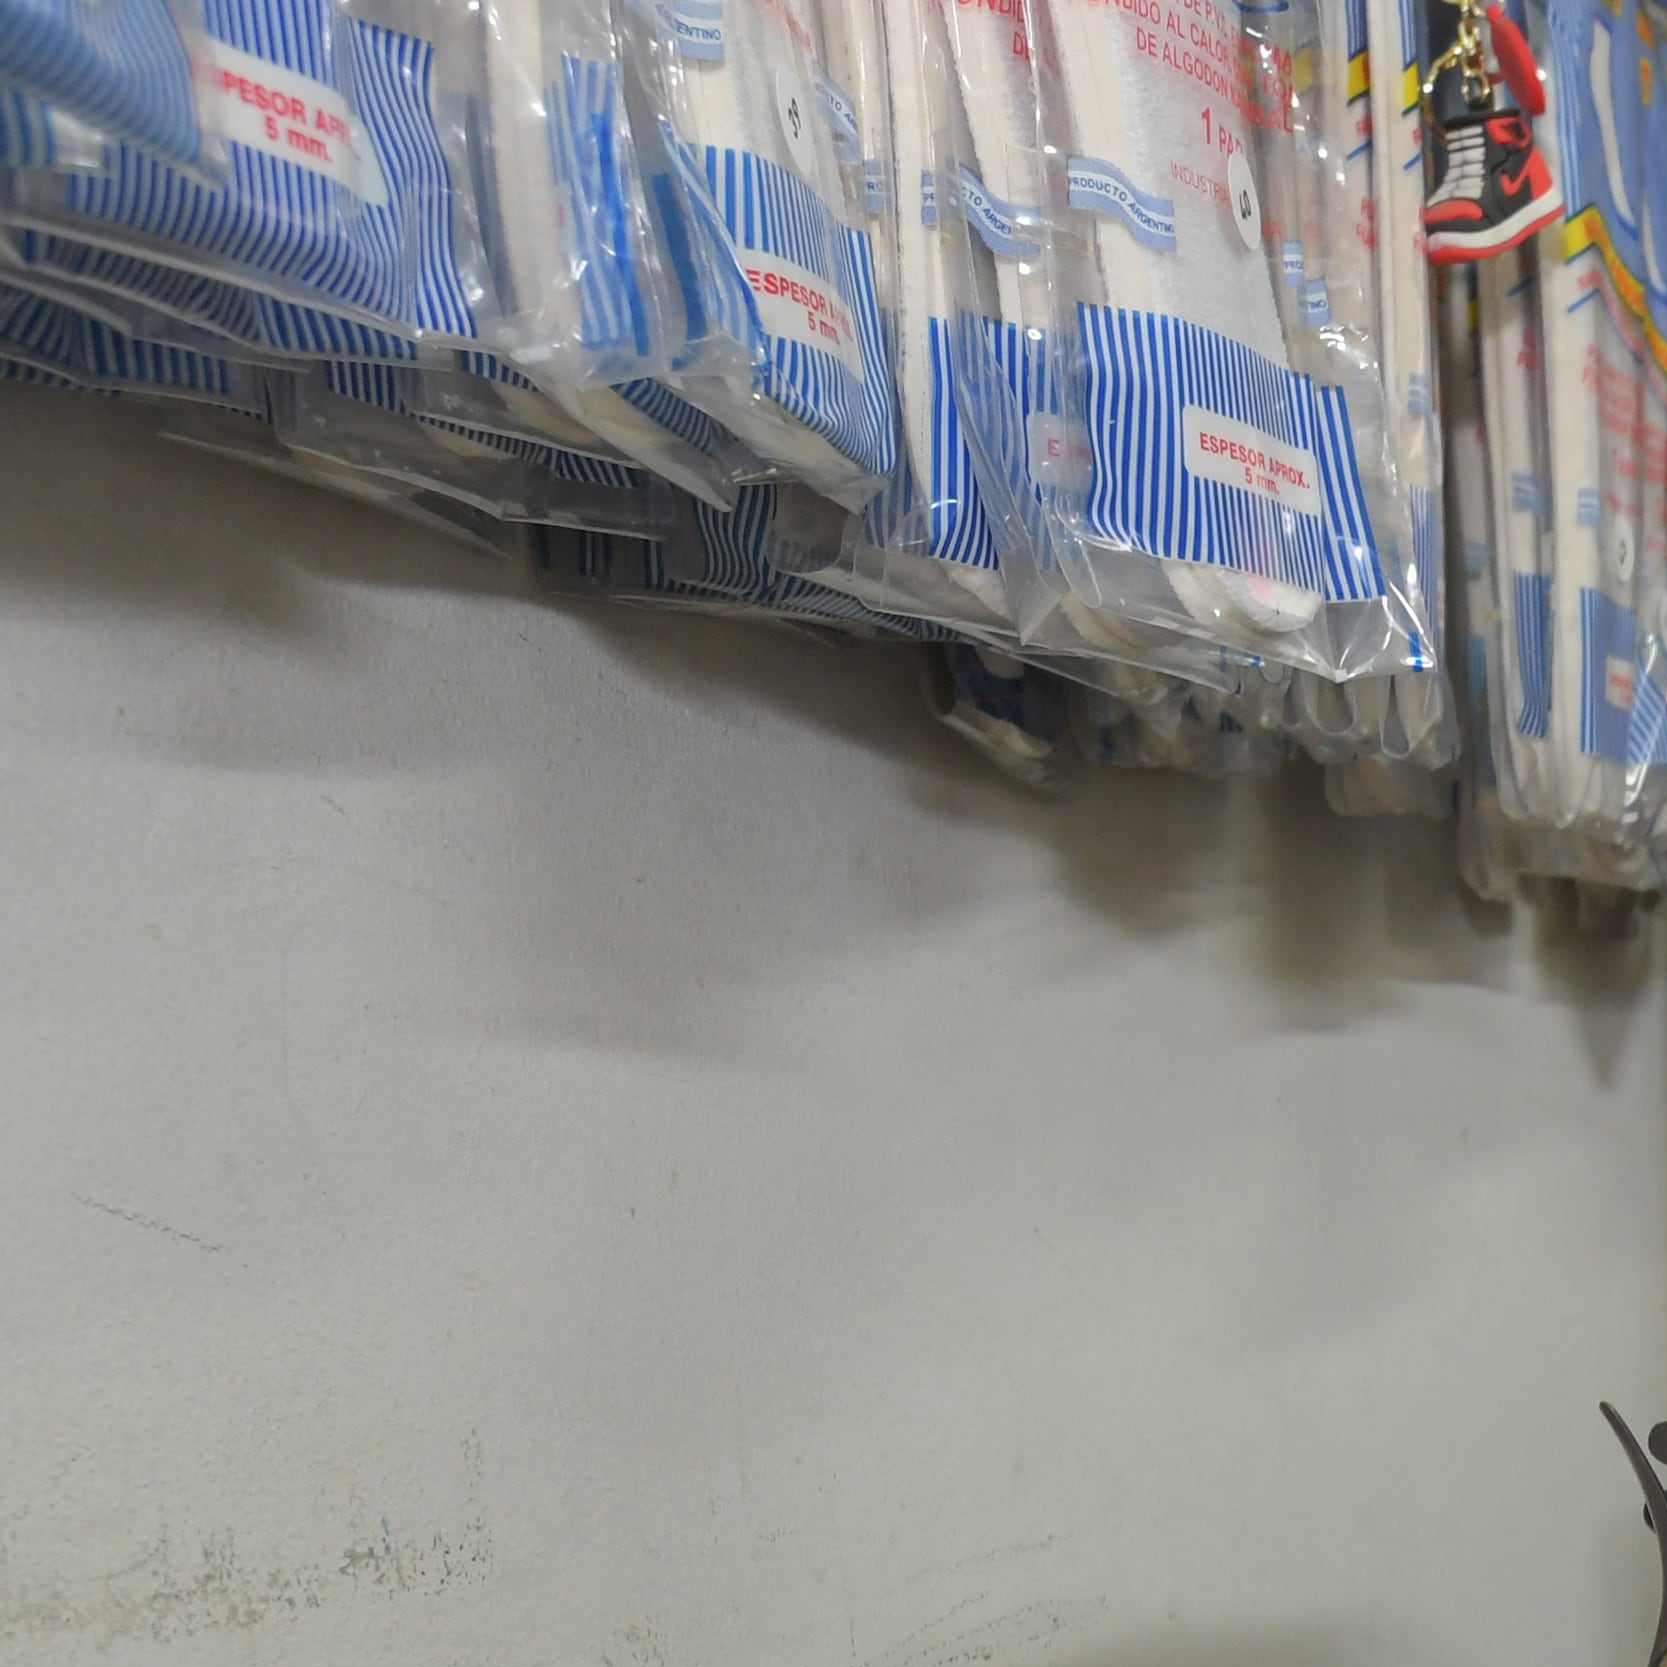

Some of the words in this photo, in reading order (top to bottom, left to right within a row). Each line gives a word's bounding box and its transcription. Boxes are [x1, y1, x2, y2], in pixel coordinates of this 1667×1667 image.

[1166, 10, 1186, 39] AL
[1136, 27, 1158, 58] DE
[265, 115, 279, 141] 5
[1201, 106, 1211, 145] 1
[807, 310, 816, 331] 5
[1199, 431, 1265, 471] ESPESOR
[1269, 456, 1311, 489] APROX.
[1244, 466, 1254, 485] 5
[1257, 474, 1280, 496] mm.
